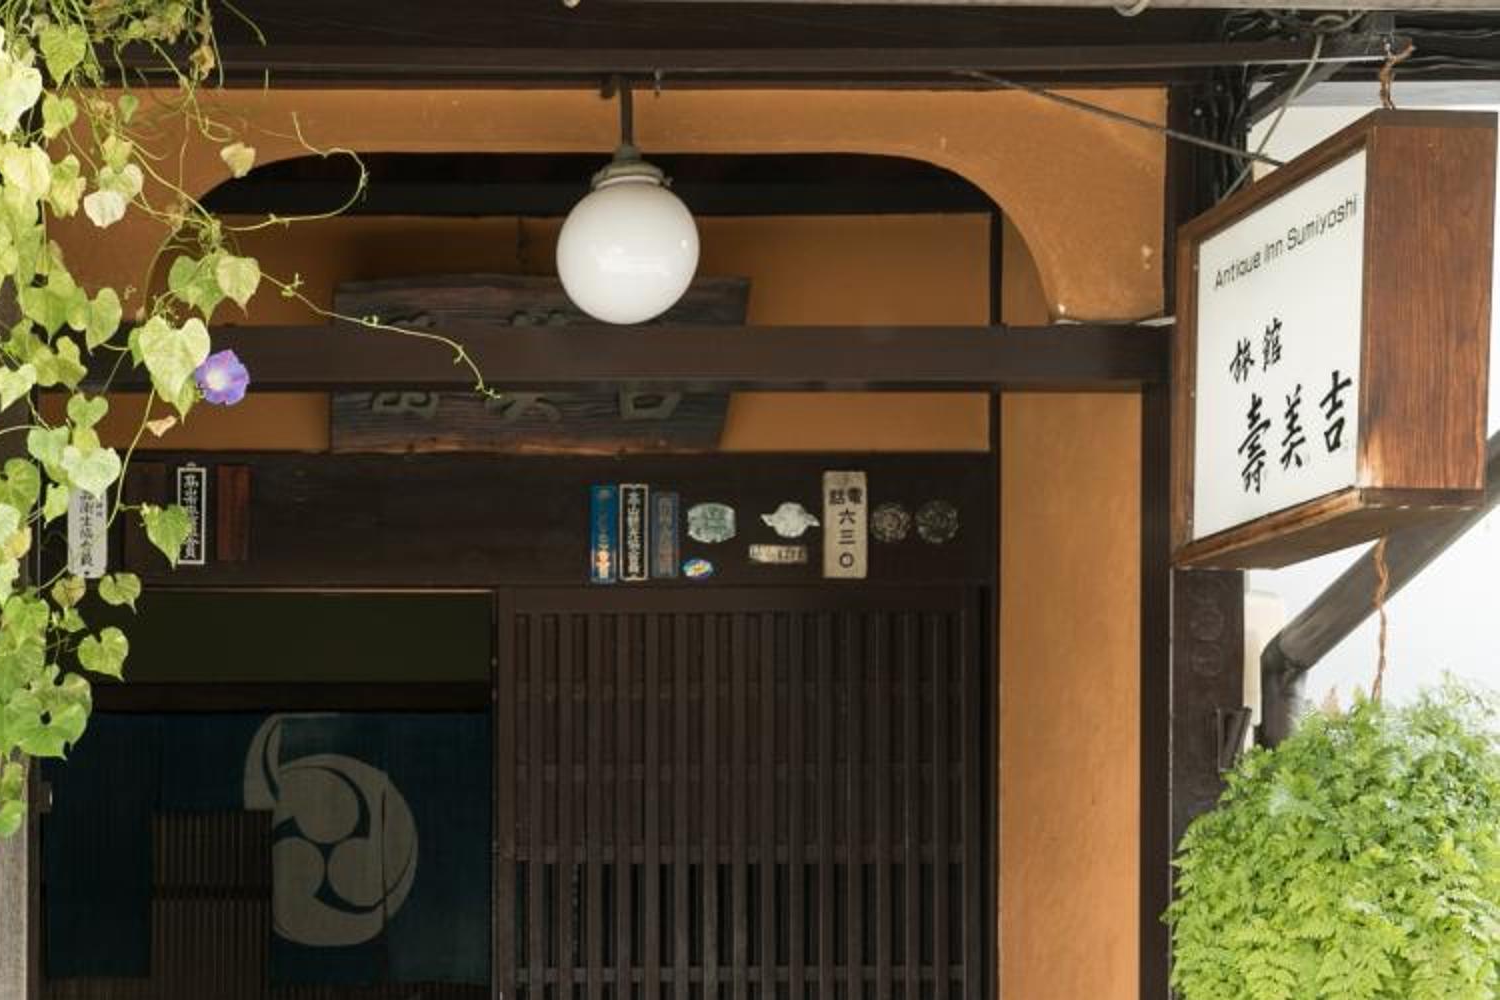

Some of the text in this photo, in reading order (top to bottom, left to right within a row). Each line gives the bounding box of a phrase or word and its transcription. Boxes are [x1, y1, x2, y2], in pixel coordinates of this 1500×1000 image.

[1214, 193, 1358, 291] Antique Inn Sumiyoshi
